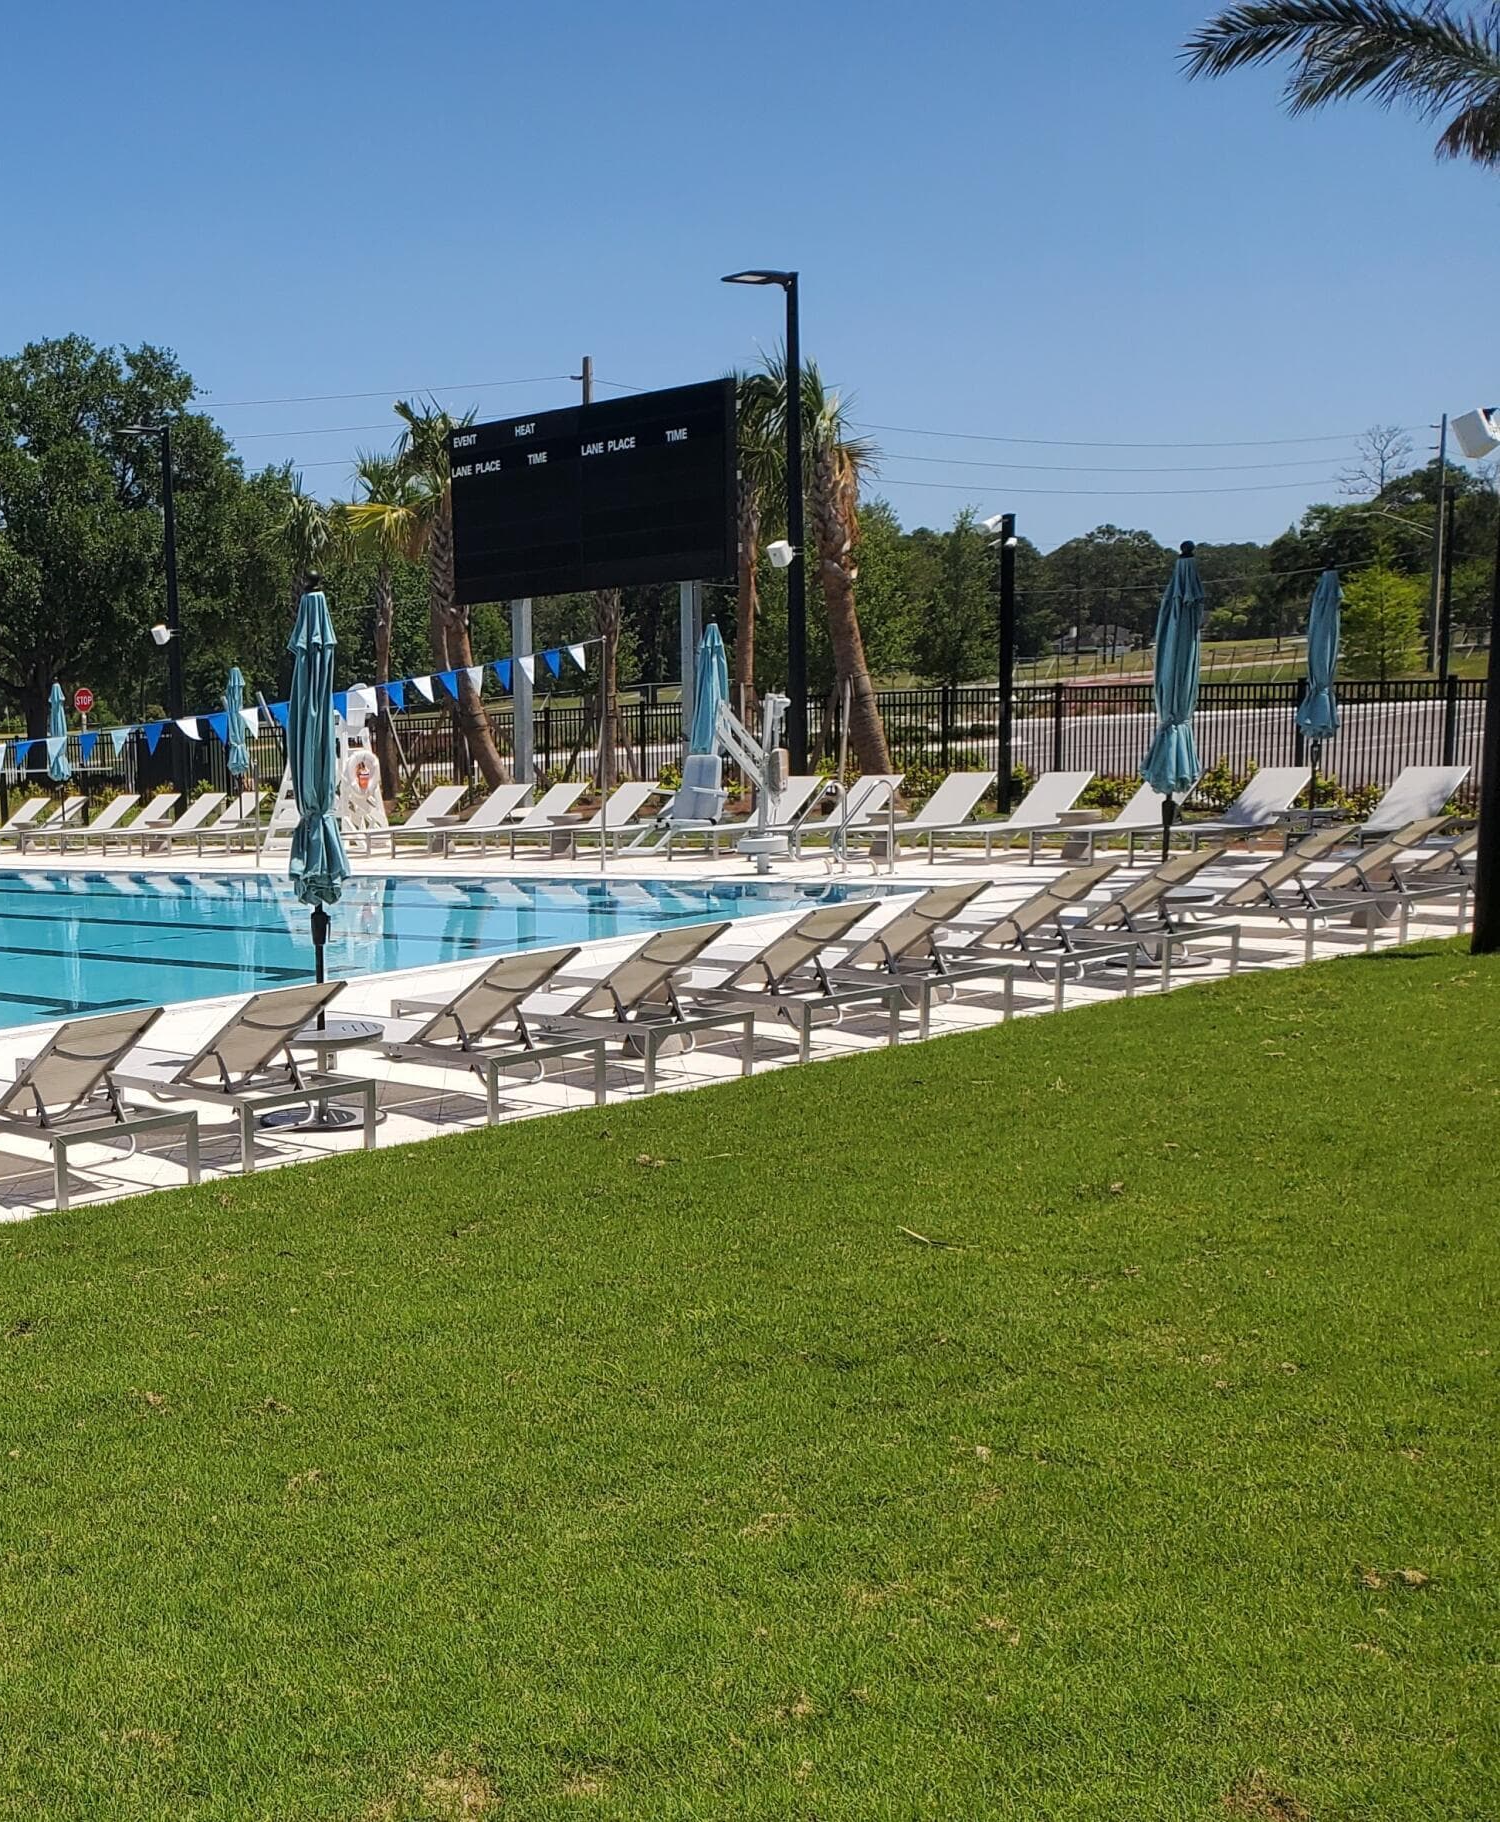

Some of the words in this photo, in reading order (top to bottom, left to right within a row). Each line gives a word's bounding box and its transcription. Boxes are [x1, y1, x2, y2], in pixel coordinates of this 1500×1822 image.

[453, 433, 477, 449] EVENT
[514, 422, 536, 437] HEAT
[581, 441, 604, 456] LANE
[607, 436, 636, 452] PLACE
[665, 427, 688, 442] TIME
[451, 464, 473, 478] LANE
[475, 459, 501, 474] PLACE
[527, 451, 548, 465] TIME
[76, 696, 92, 705] STOP
